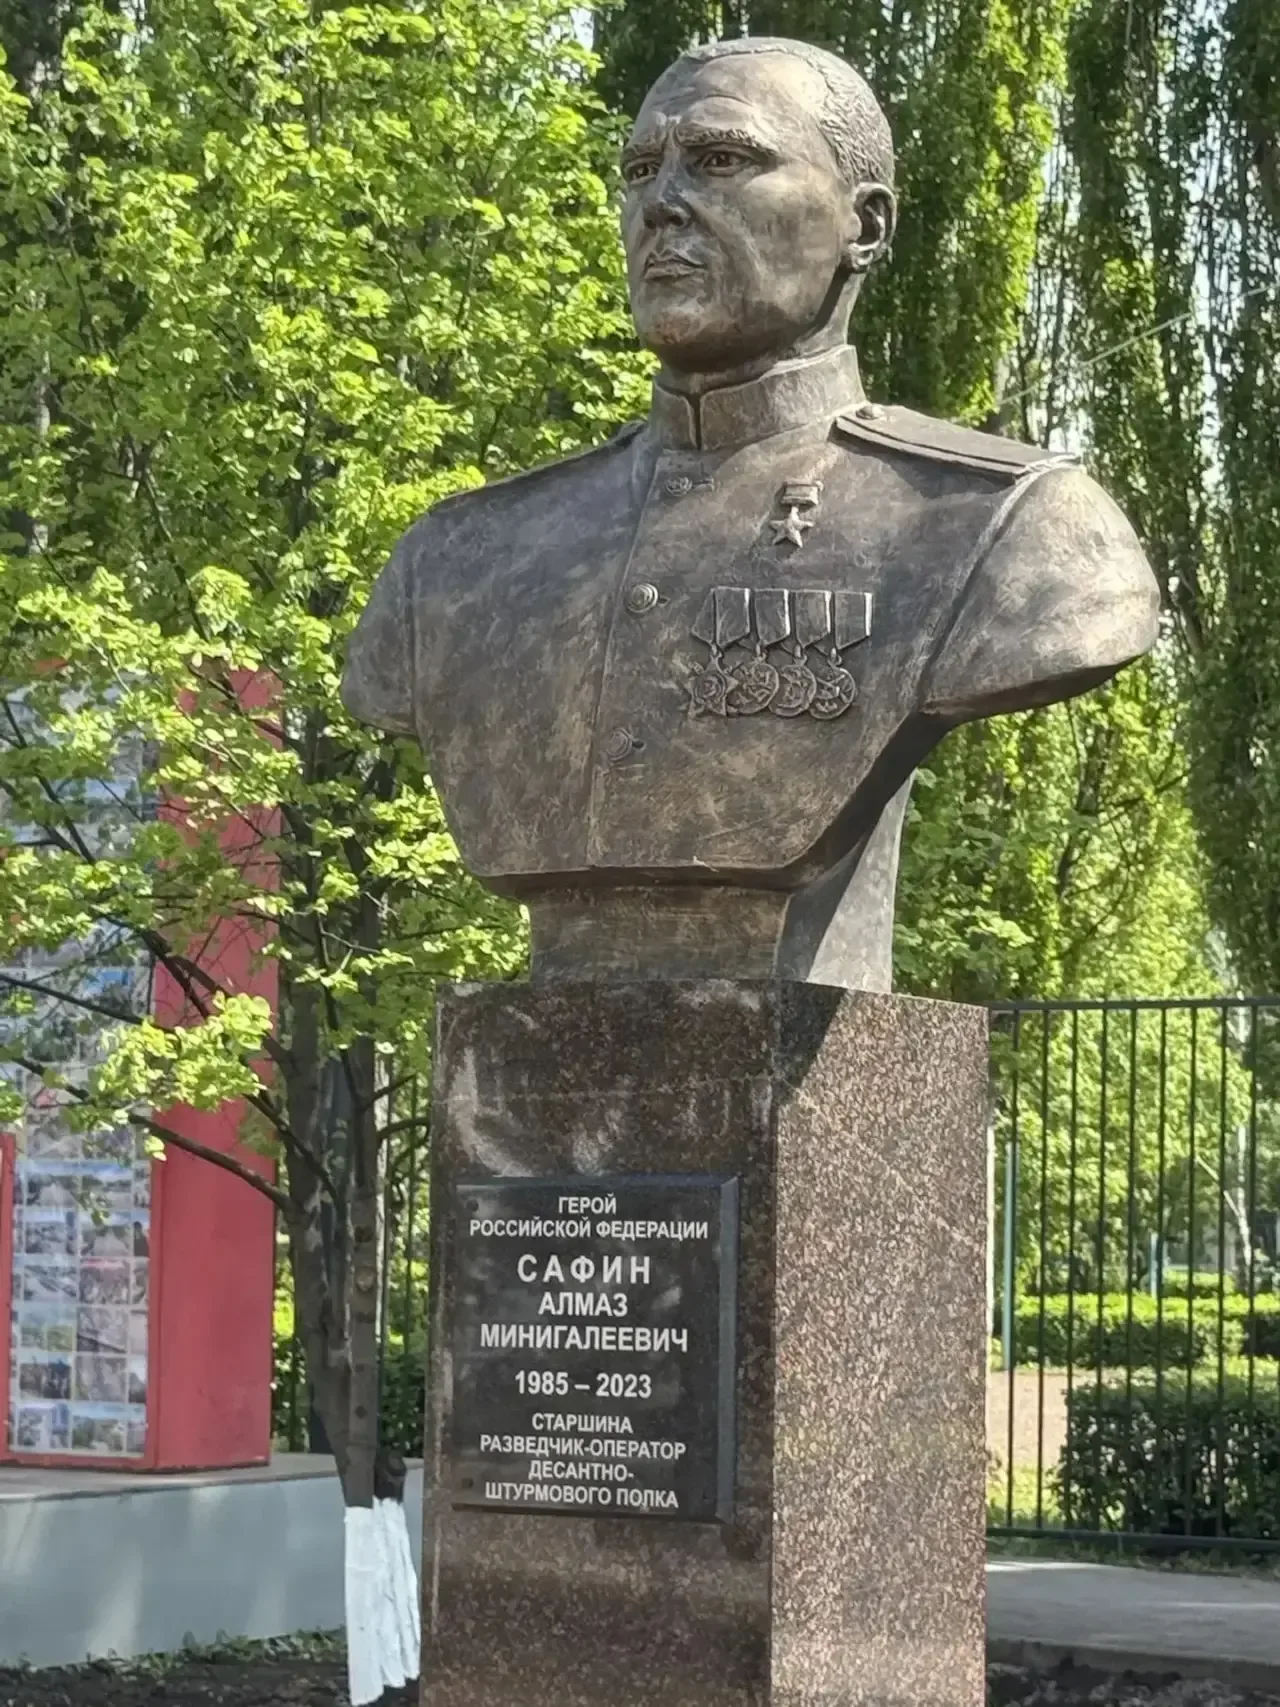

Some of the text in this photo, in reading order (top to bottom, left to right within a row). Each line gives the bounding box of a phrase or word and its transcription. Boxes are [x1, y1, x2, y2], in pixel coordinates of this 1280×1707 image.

[558, 1193, 617, 1214] ГЕРОЙ
[469, 1216, 708, 1242] РОССИЙСКОЙ ФЕДЕРАЦИИ
[517, 1254, 650, 1284] САФИН
[538, 1292, 628, 1317] АЛМАЗ
[480, 1324, 688, 1353] МИНИГАЛЕЕВИЧ
[514, 1370, 569, 1396] 1985
[596, 1373, 652, 1398] 2023
[531, 1413, 633, 1434] СТАРШИНА
[480, 1434, 686, 1460] РАЗВЕДЧИК-ОПЕРАТОР
[528, 1461, 634, 1482] ДЕСАНТНО-
[485, 1482, 679, 1509] ШТУРМОВОГО ПОЛКА
